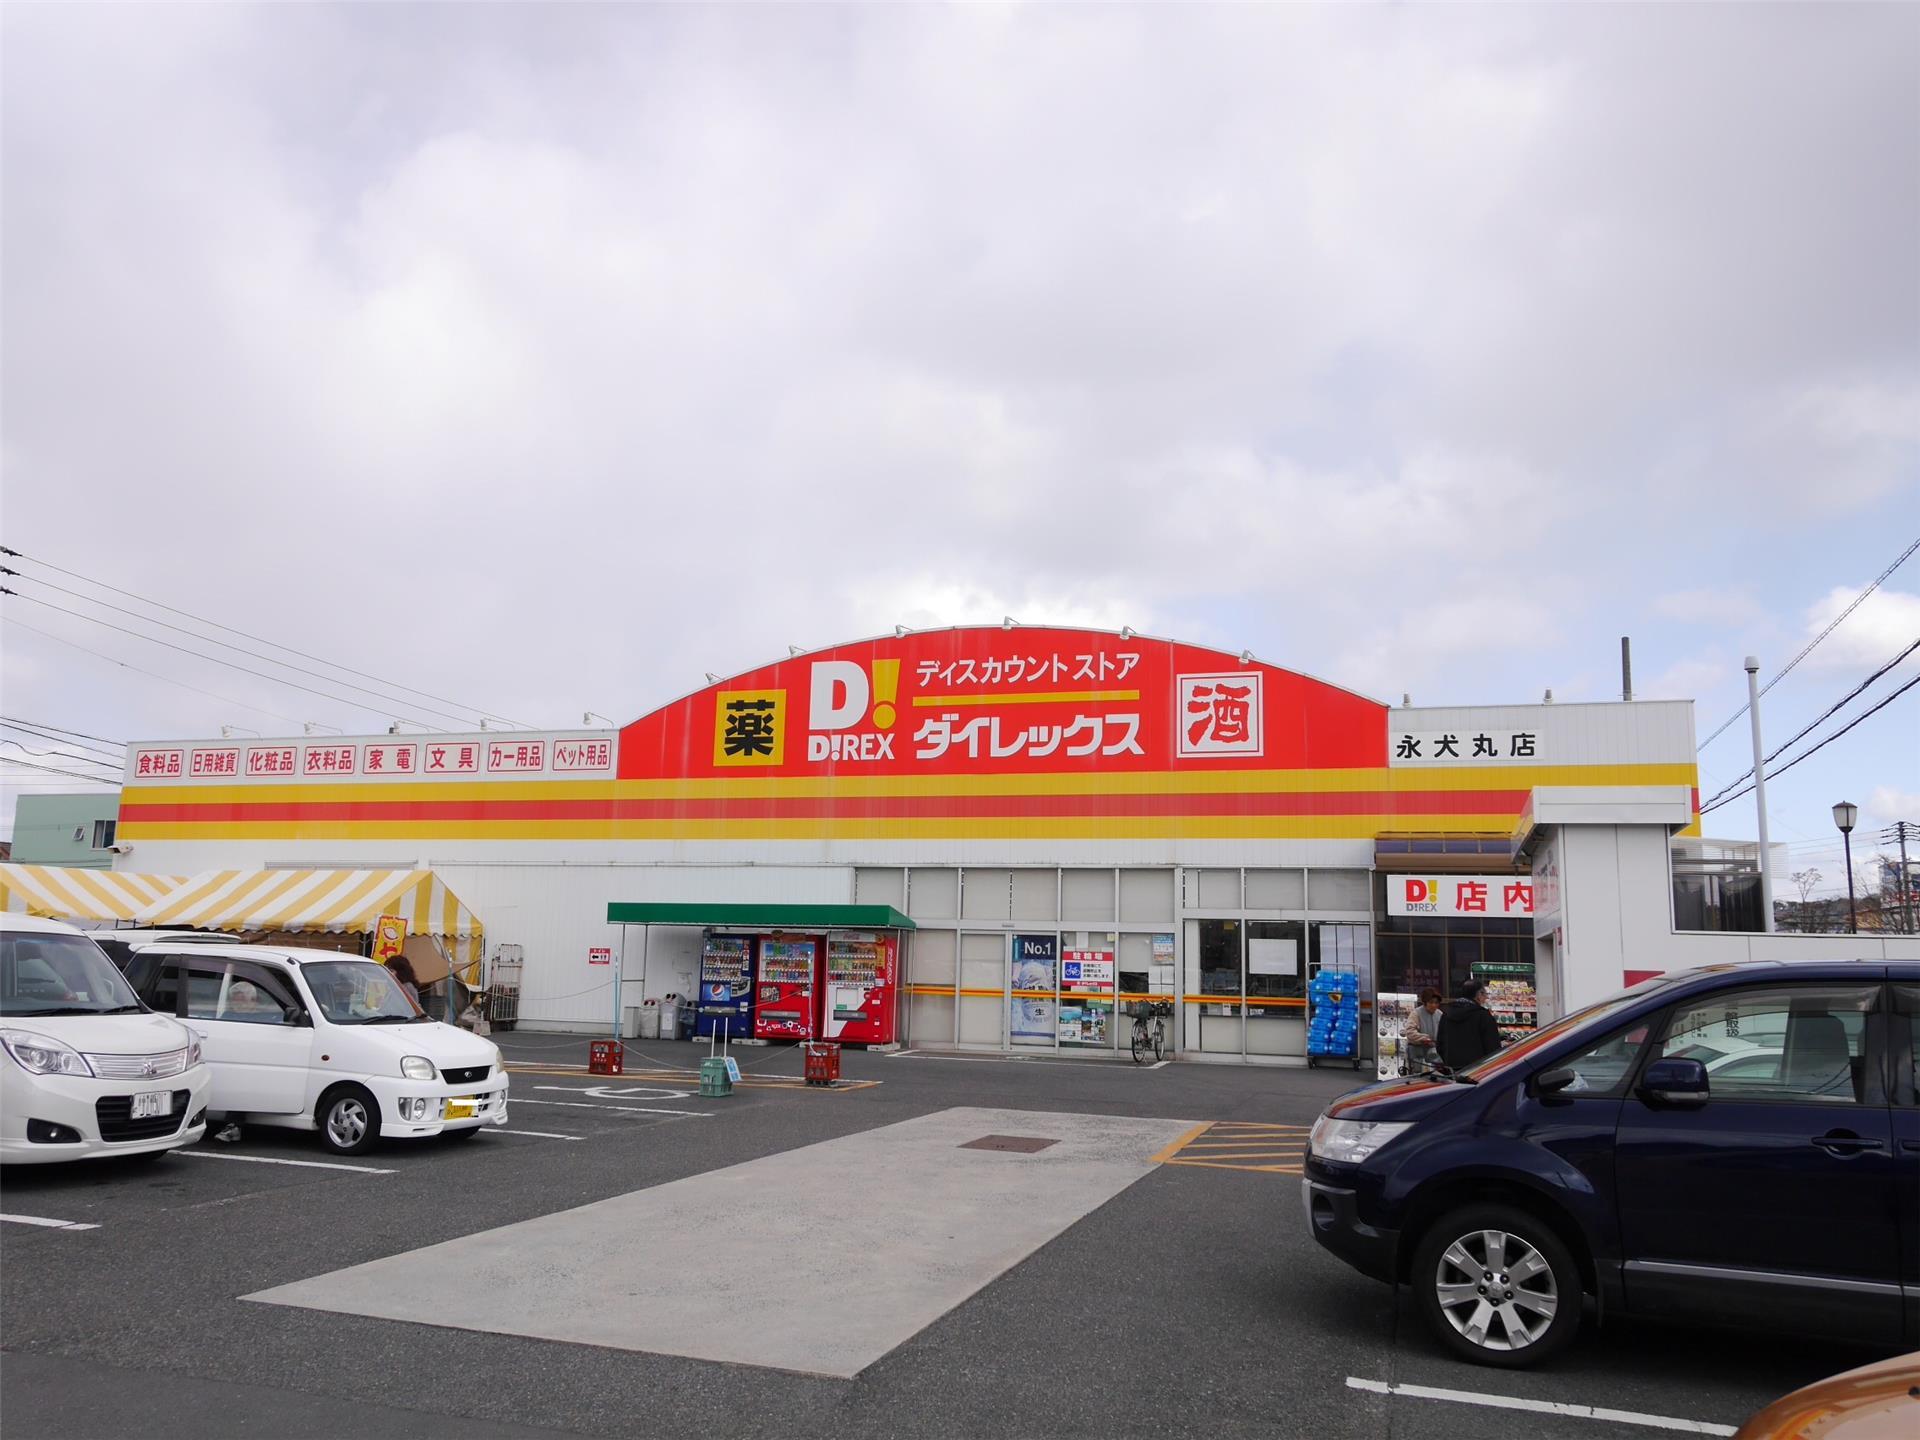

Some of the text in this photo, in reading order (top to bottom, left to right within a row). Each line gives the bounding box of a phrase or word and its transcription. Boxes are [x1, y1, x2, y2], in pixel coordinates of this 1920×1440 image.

[1187, 683, 1251, 746] 酒
[723, 699, 775, 756] 薬
[913, 713, 1145, 759] ダイレックス
[490, 746, 541, 767] カー用品
[556, 744, 608, 766] ペット用品
[1396, 733, 1536, 759] 永犬丸店
[138, 753, 180, 774] 食料品
[192, 752, 236, 773] 日用雑貨
[249, 751, 293, 771] 化粧品
[307, 750, 352, 771] 衣料品
[369, 748, 411, 770] 家電
[430, 747, 473, 769] 文具
[1455, 881, 1534, 912] 店内
[1024, 942, 1052, 955] No.1
